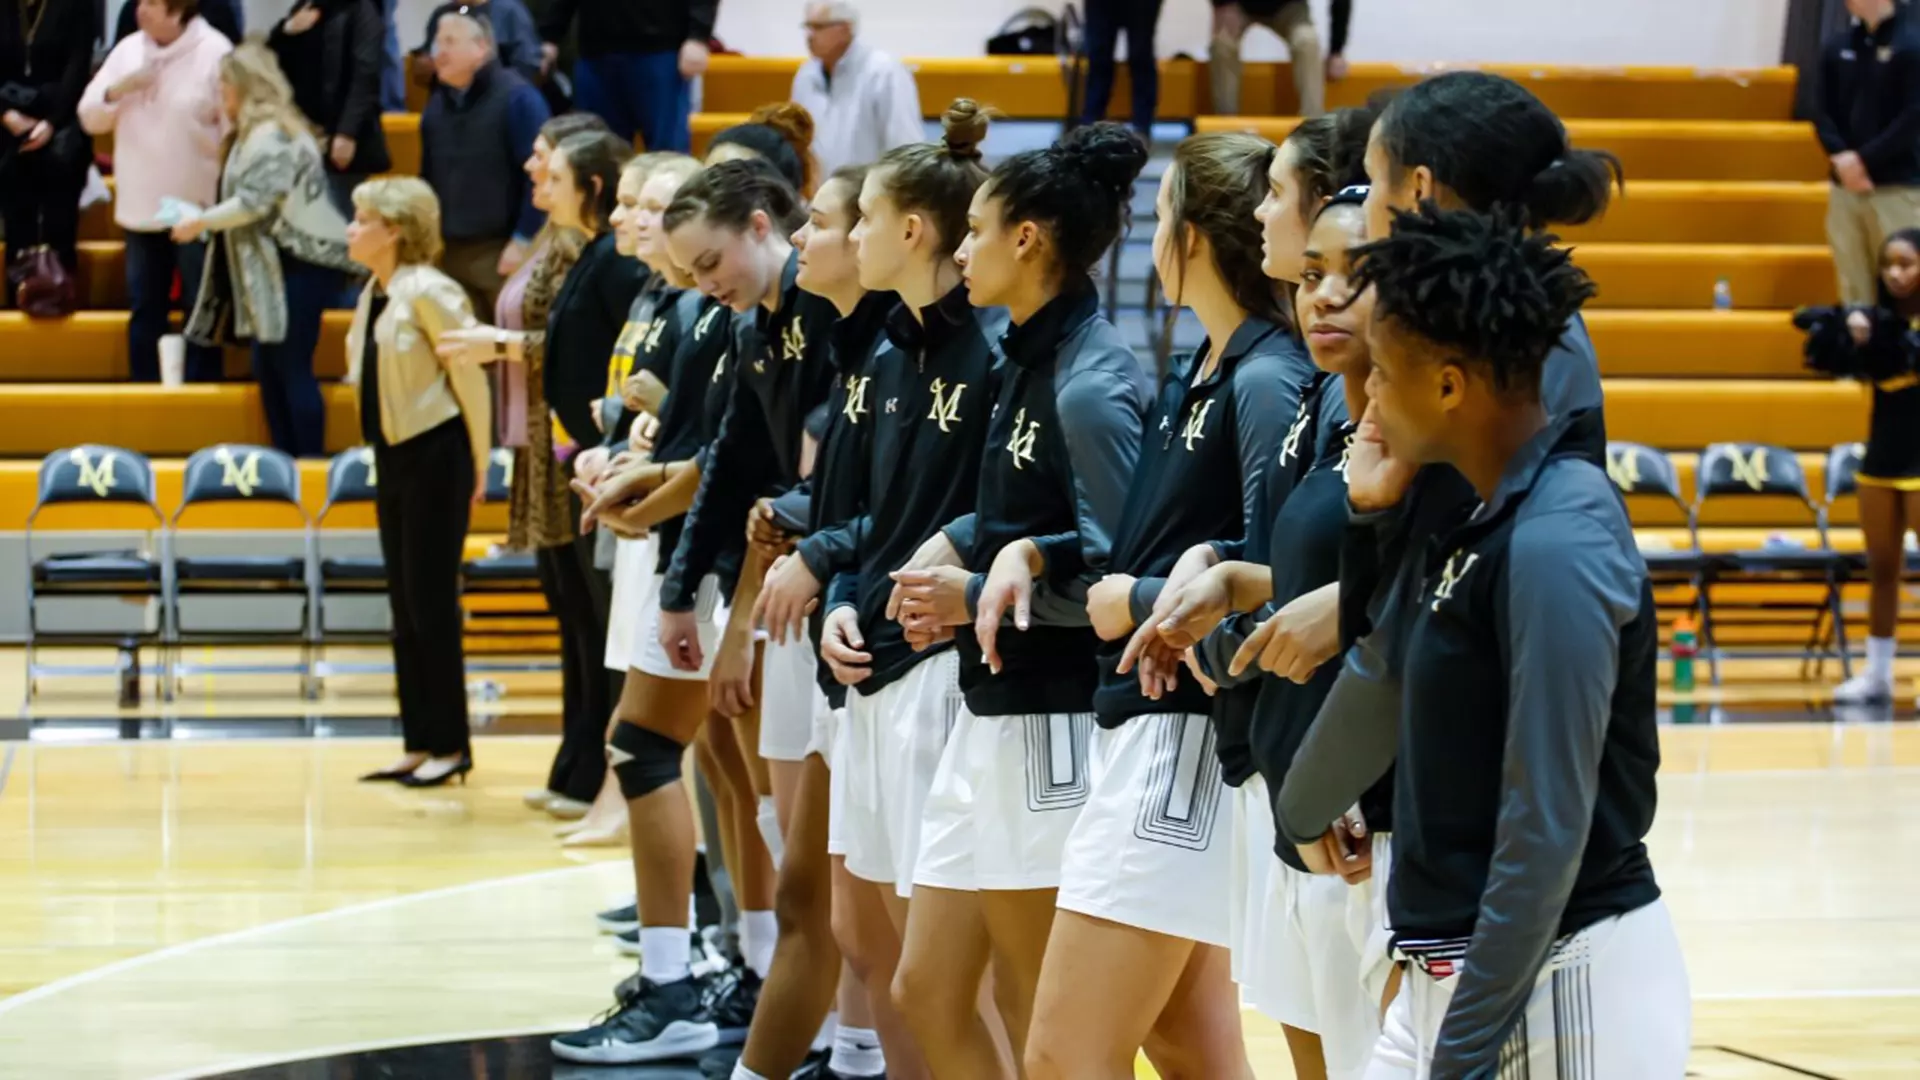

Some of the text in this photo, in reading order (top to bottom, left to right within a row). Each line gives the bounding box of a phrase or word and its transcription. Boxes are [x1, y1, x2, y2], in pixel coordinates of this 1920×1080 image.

[927, 377, 967, 433] M
[70, 447, 116, 497] M
[215, 447, 261, 497] M
[1725, 444, 1769, 491] M
